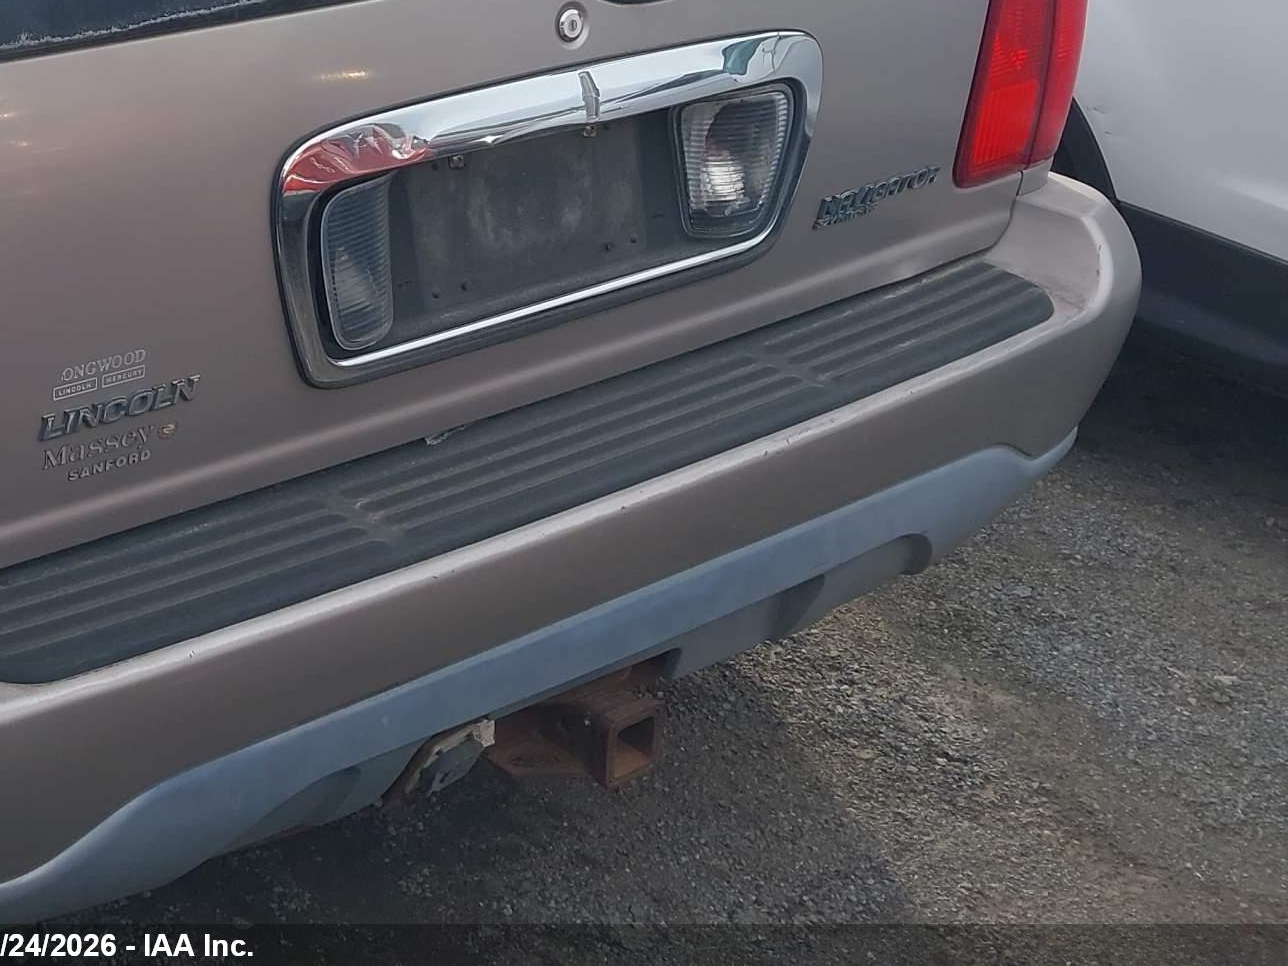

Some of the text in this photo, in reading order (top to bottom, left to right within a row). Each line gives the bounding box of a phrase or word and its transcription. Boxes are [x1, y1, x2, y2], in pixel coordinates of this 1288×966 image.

[816, 165, 941, 220] NAVIGATOR
[60, 349, 146, 382] ONGWOOD
[39, 374, 201, 442] LINCOLN
[67, 449, 151, 482] SANFORD
